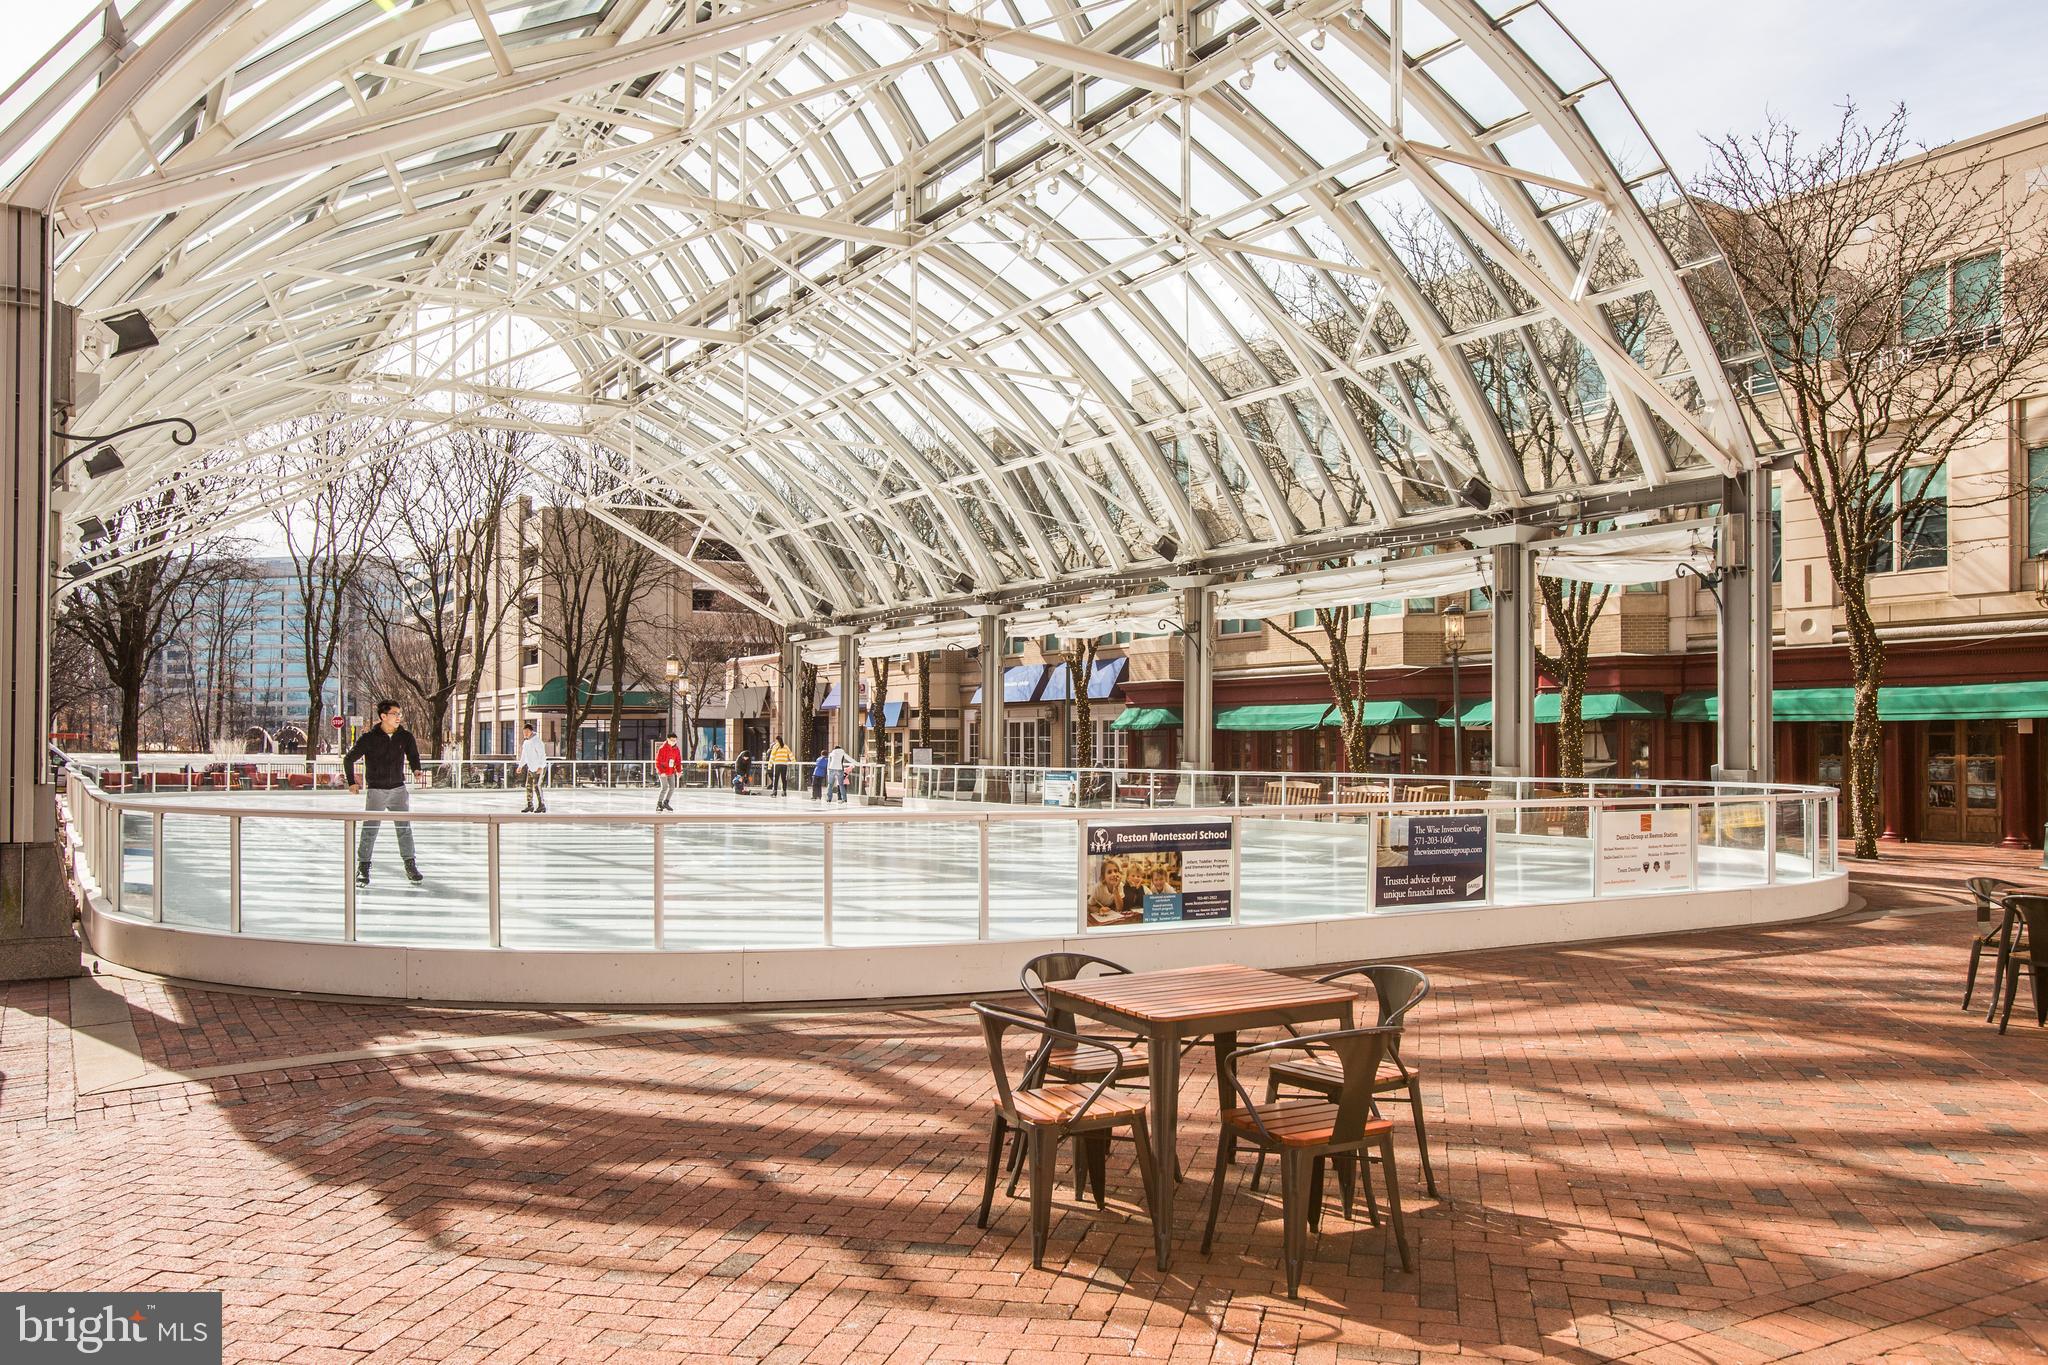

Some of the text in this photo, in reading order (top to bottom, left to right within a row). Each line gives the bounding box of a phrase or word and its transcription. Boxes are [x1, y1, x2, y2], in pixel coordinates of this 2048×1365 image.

[1414, 824, 1481, 834] The Wise Investor Group
[1116, 830, 1227, 842] Reston Montessori School
[1414, 836, 1454, 845] 571-203-1600
[1414, 847, 1483, 856] thewiseinvestorgroup.com
[1384, 873, 1456, 886] Trusted advice for your
[1384, 885, 1455, 901] unique financial needs.
